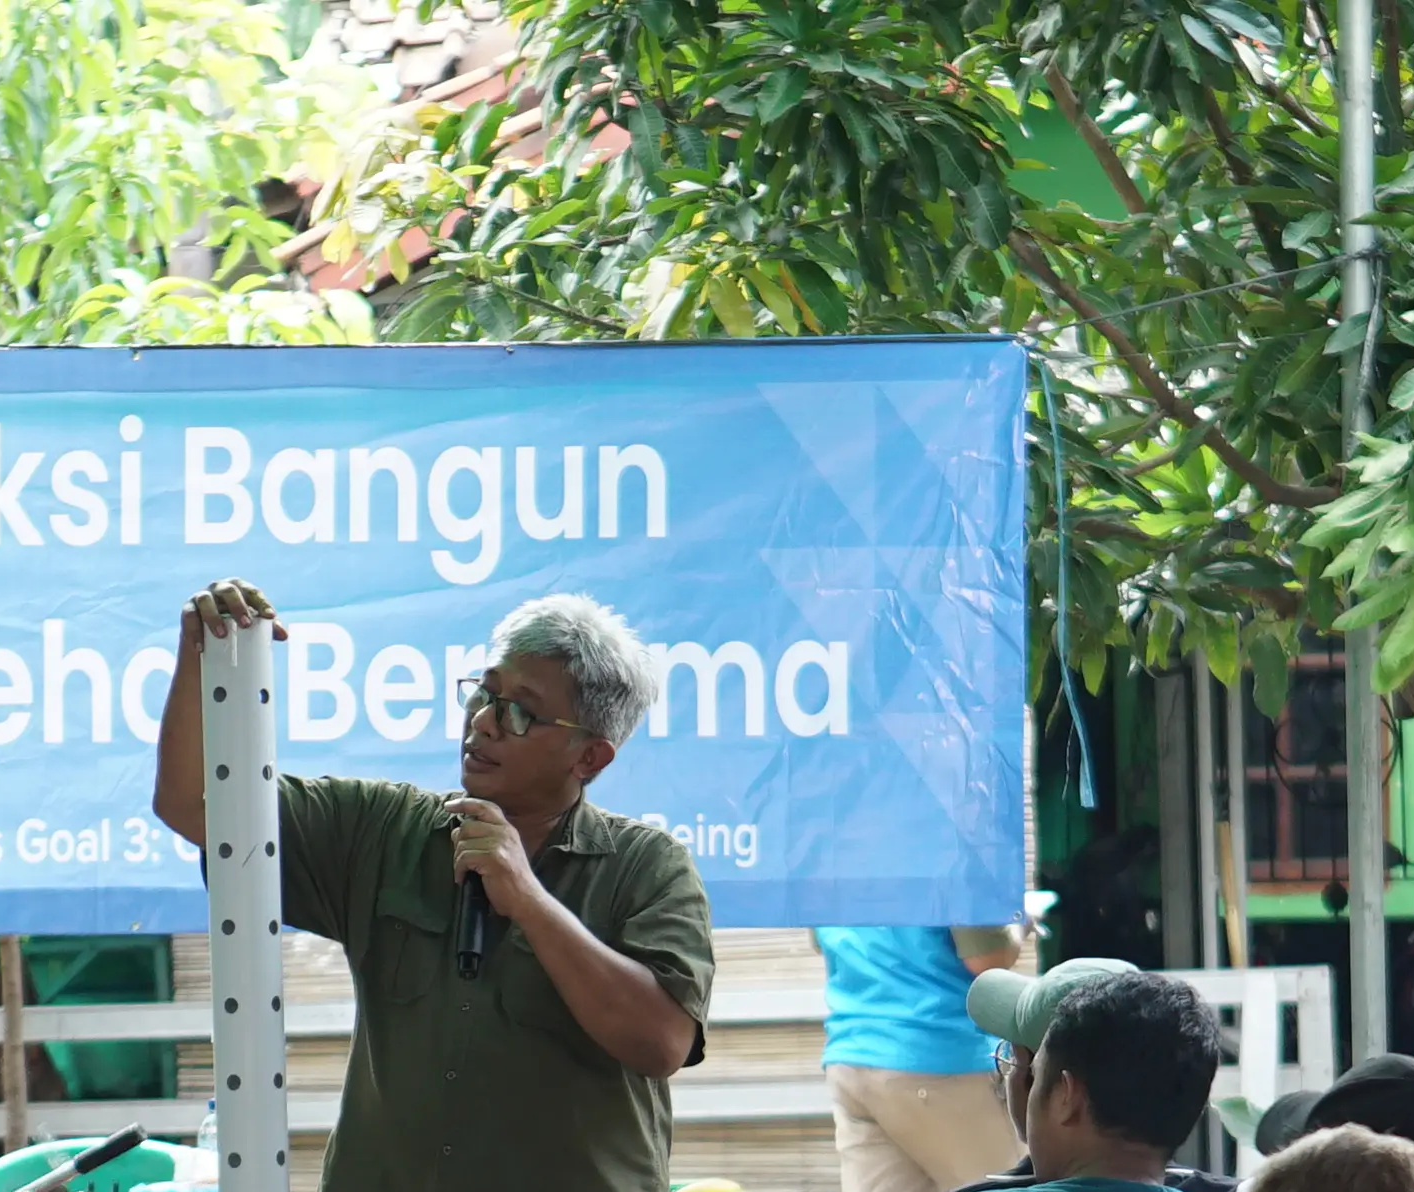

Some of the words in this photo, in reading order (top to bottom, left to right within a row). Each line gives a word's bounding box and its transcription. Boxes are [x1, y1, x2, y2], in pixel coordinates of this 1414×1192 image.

[185, 426, 668, 585] Bangun
[287, 621, 848, 742] Berma
[16, 817, 110, 863] Goal
[123, 817, 161, 863] 3:
